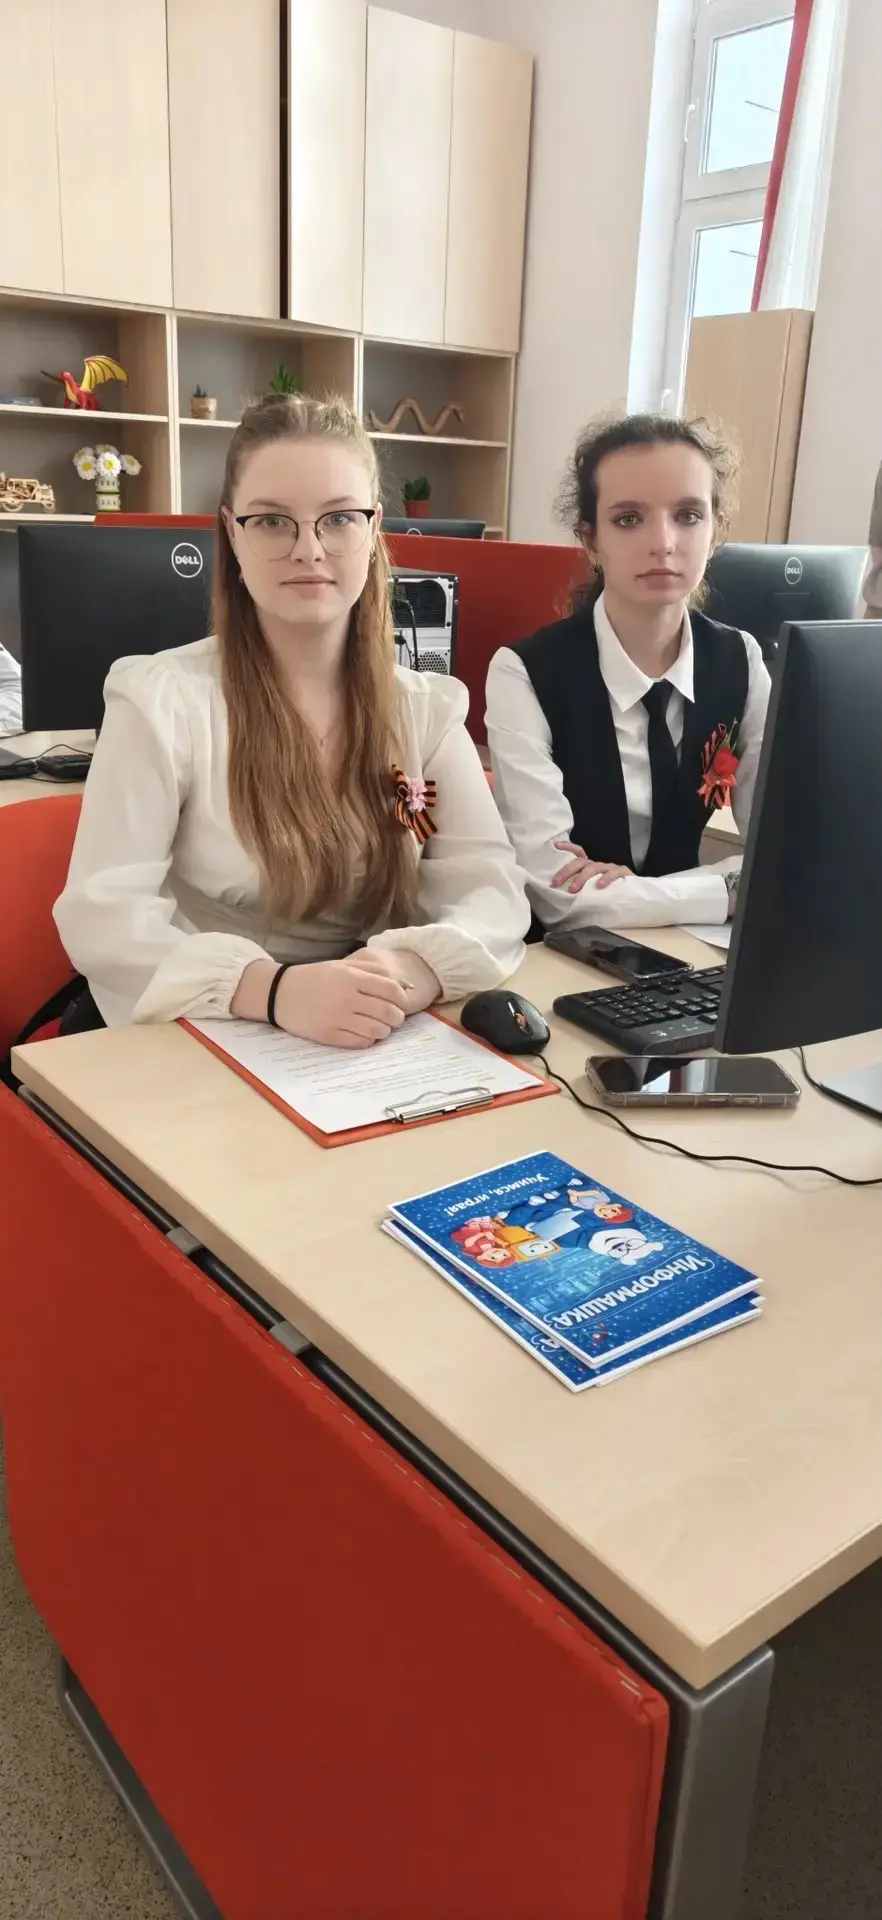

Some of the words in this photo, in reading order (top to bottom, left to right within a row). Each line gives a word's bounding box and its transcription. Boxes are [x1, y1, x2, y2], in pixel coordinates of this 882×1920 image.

[175, 555, 200, 565] DELL
[488, 1172, 550, 1196] Учимся,
[443, 1193, 491, 1217] играя!
[551, 1254, 706, 1328] ИНФОРМАШКА
